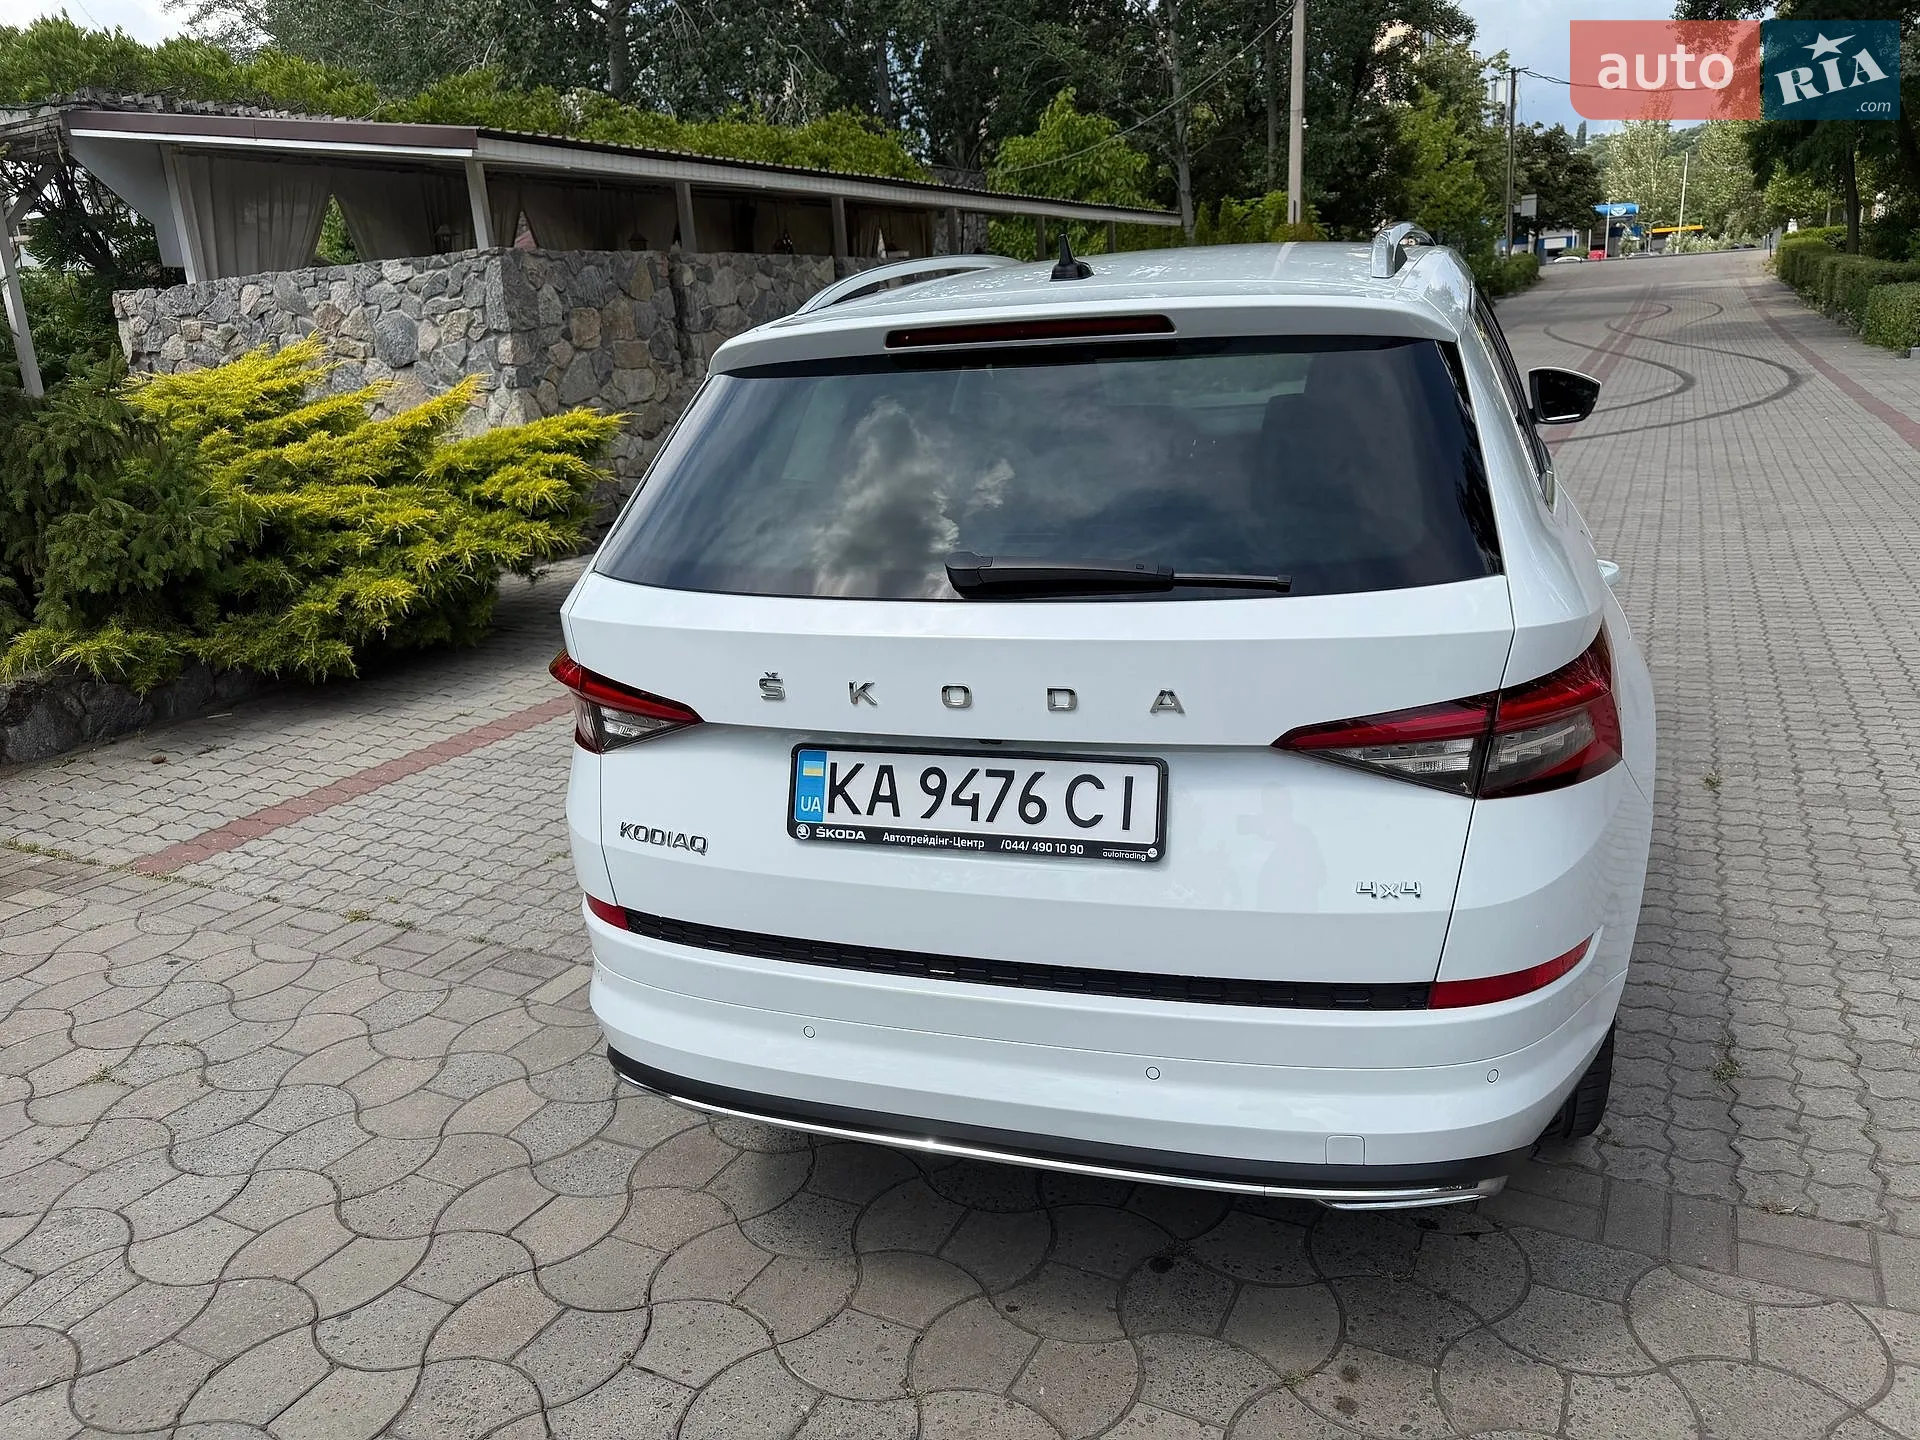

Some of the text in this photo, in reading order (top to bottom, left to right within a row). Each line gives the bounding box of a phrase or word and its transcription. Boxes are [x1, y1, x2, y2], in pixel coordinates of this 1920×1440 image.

[758, 671, 1186, 715] ŠKODA
[801, 795, 822, 812] UA
[828, 762, 1134, 831] KA 9476 CI
[619, 821, 708, 856] KODIAQ
[816, 826, 867, 841] ŠKODA
[882, 831, 985, 850] Автотрейдінг-Центр
[1000, 839, 1084, 855] /044/ 490 10 90
[1355, 881, 1421, 899] 4x4
